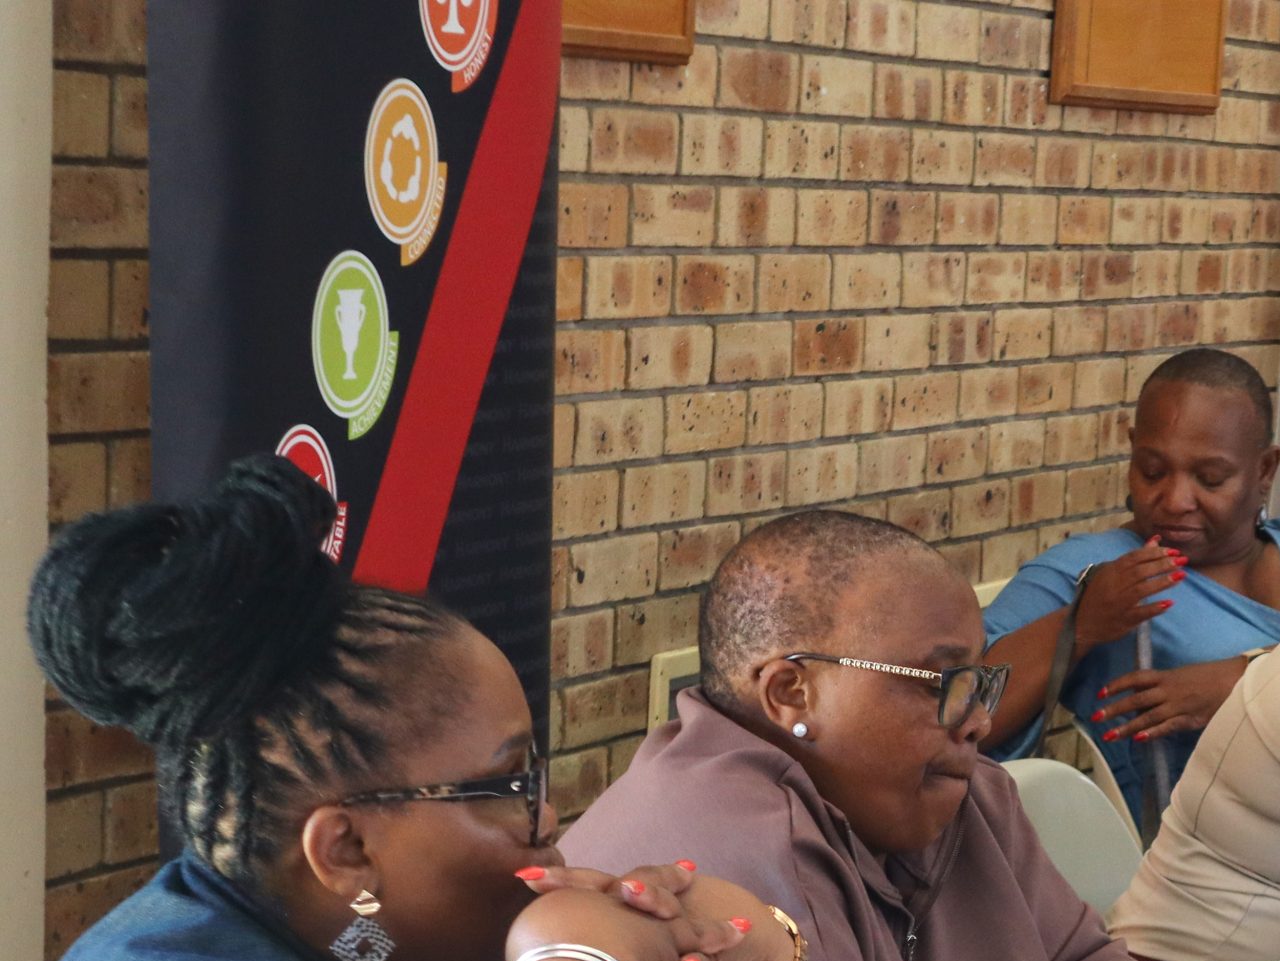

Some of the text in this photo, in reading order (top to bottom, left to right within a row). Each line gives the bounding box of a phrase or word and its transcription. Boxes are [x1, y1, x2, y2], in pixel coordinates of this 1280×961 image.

[464, 32, 492, 83] HONEST
[409, 176, 445, 259] CONNECTED
[352, 341, 397, 433] ACHIEVEMENT
